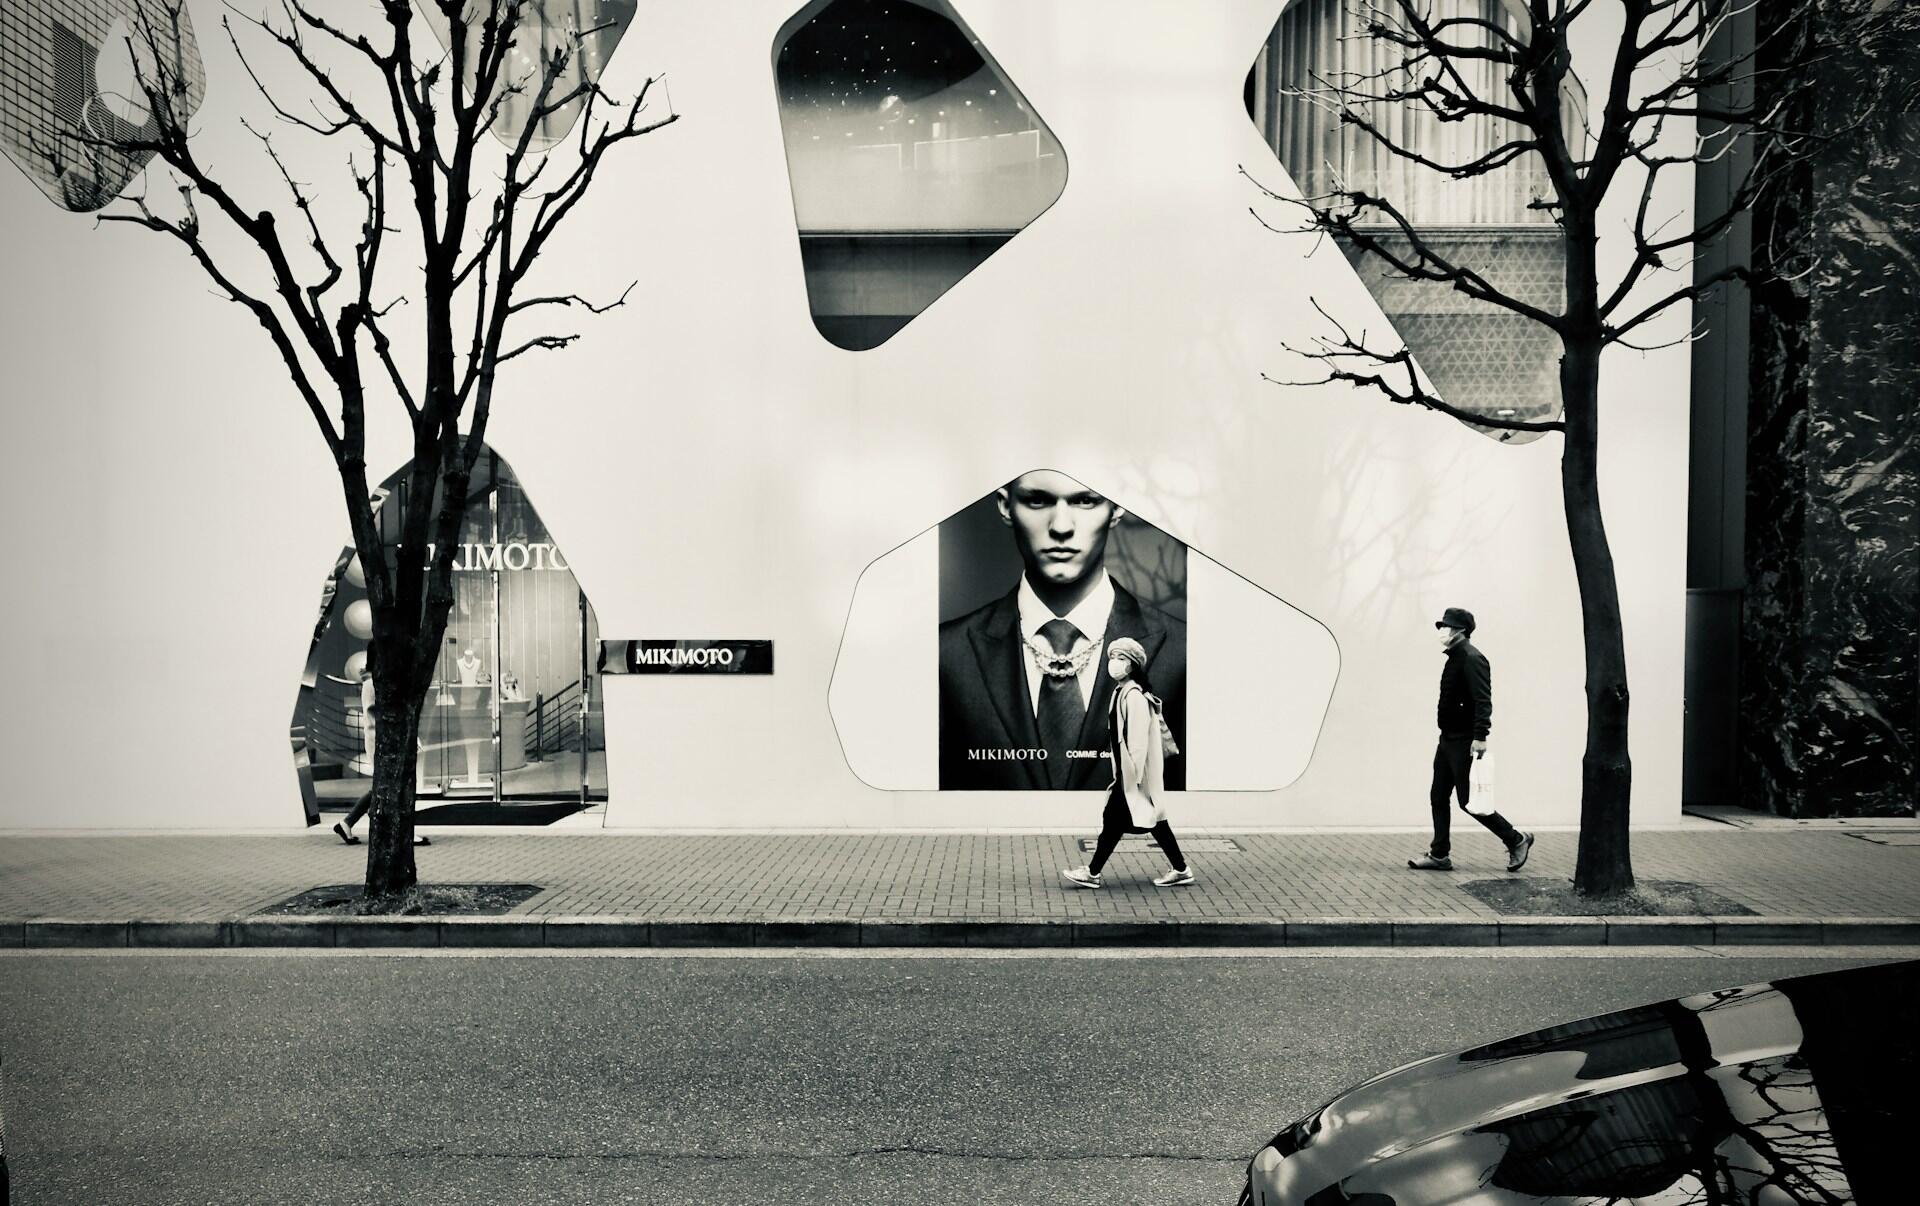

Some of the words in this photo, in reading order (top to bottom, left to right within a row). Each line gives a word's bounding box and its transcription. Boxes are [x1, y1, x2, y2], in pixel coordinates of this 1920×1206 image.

[635, 647, 734, 665] MIKIMOTO
[967, 748, 1048, 761] MIKIMOTO
[1065, 750, 1098, 759] COMME
